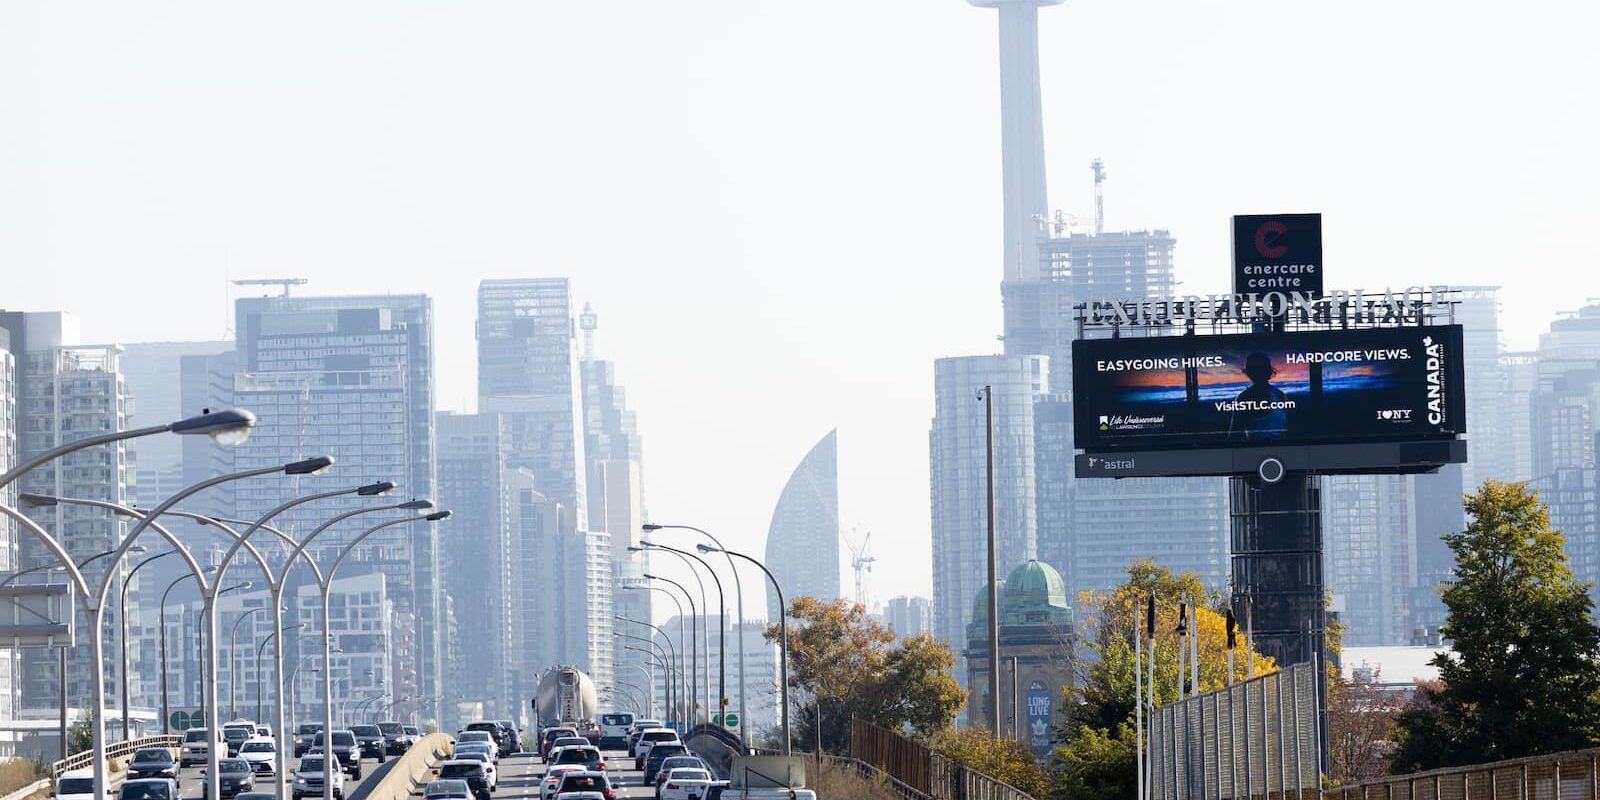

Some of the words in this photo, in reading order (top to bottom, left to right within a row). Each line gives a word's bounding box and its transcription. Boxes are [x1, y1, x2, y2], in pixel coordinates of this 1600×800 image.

[1243, 264, 1315, 275] enercare
[1248, 276, 1301, 288] centre
[1083, 290, 1315, 326] EXHIBITION
[1329, 285, 1449, 315] PLACE
[1286, 350, 1362, 365] HARDCORE
[1364, 348, 1412, 361] VIEWS.
[1097, 357, 1179, 372] EASYGOING
[1181, 355, 1227, 369] HIKES.
[1426, 343, 1442, 425] CANADA
[1215, 400, 1296, 412] VisitSTLC.com
[1104, 458, 1135, 470] astral
[1028, 696, 1050, 706] LONG
[1030, 706, 1049, 716] LIVE
